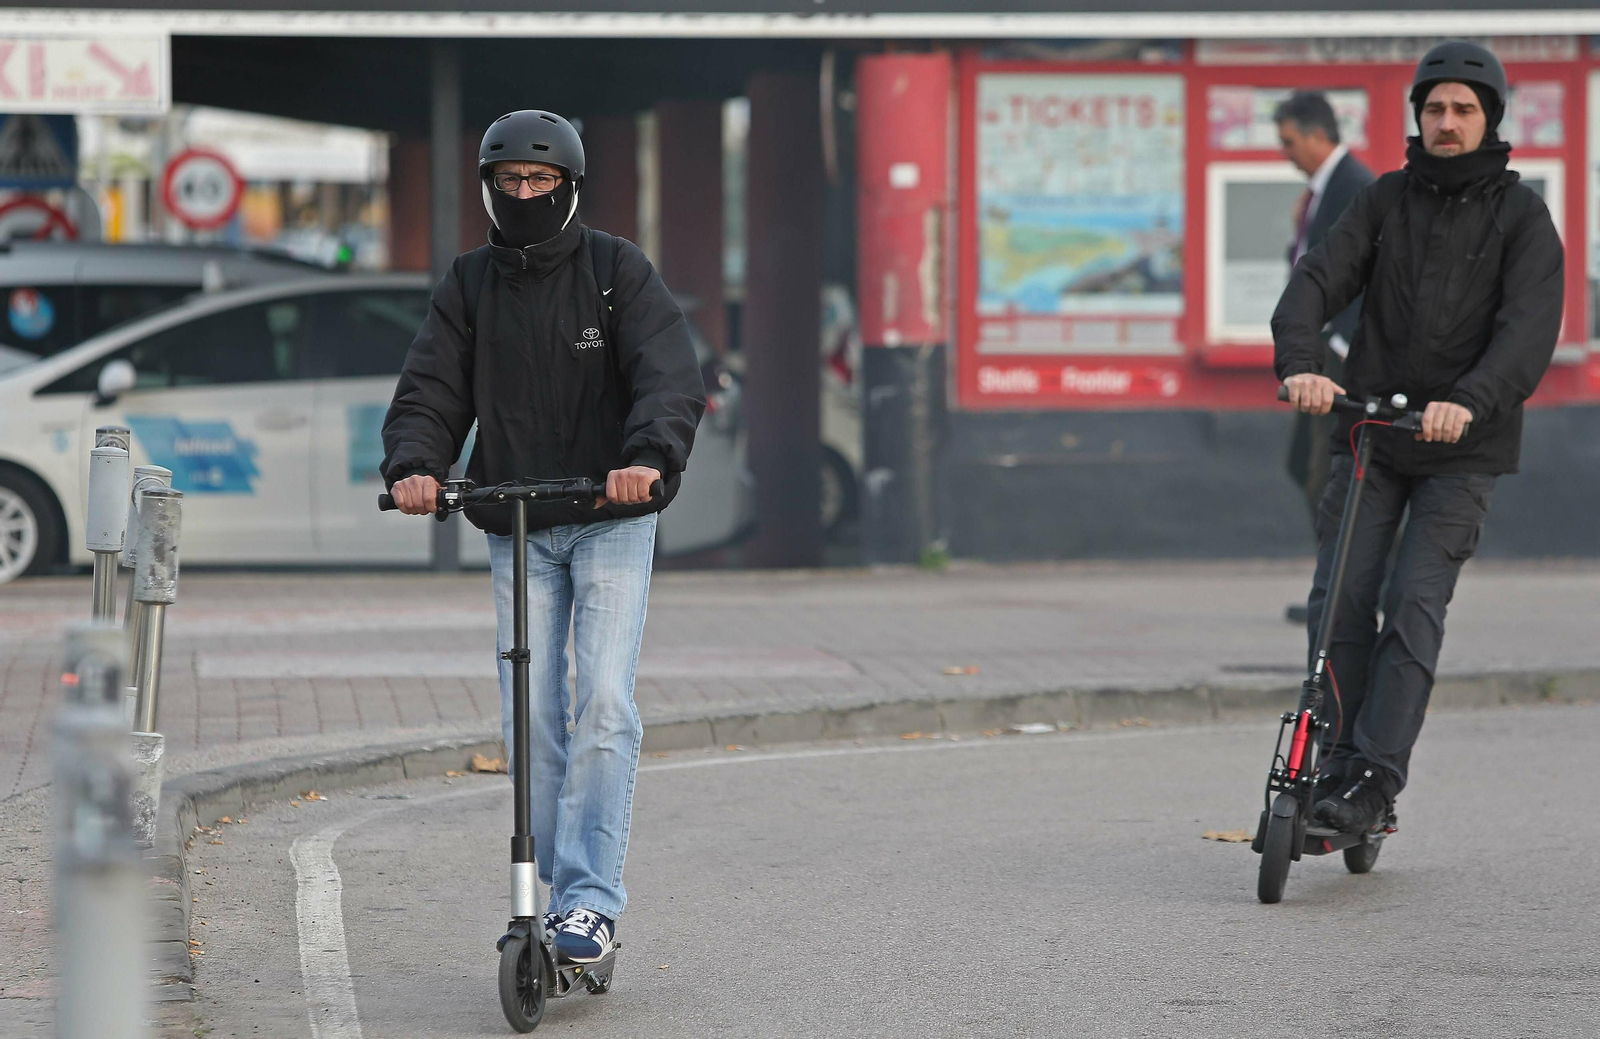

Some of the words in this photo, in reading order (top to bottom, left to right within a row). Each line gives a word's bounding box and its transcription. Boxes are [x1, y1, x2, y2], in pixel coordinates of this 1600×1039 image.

[1009, 94, 1156, 128] TICKETS
[574, 340, 605, 350] TOYOT
[978, 366, 1038, 395] Shuttle
[1060, 366, 1131, 395] Frontier
